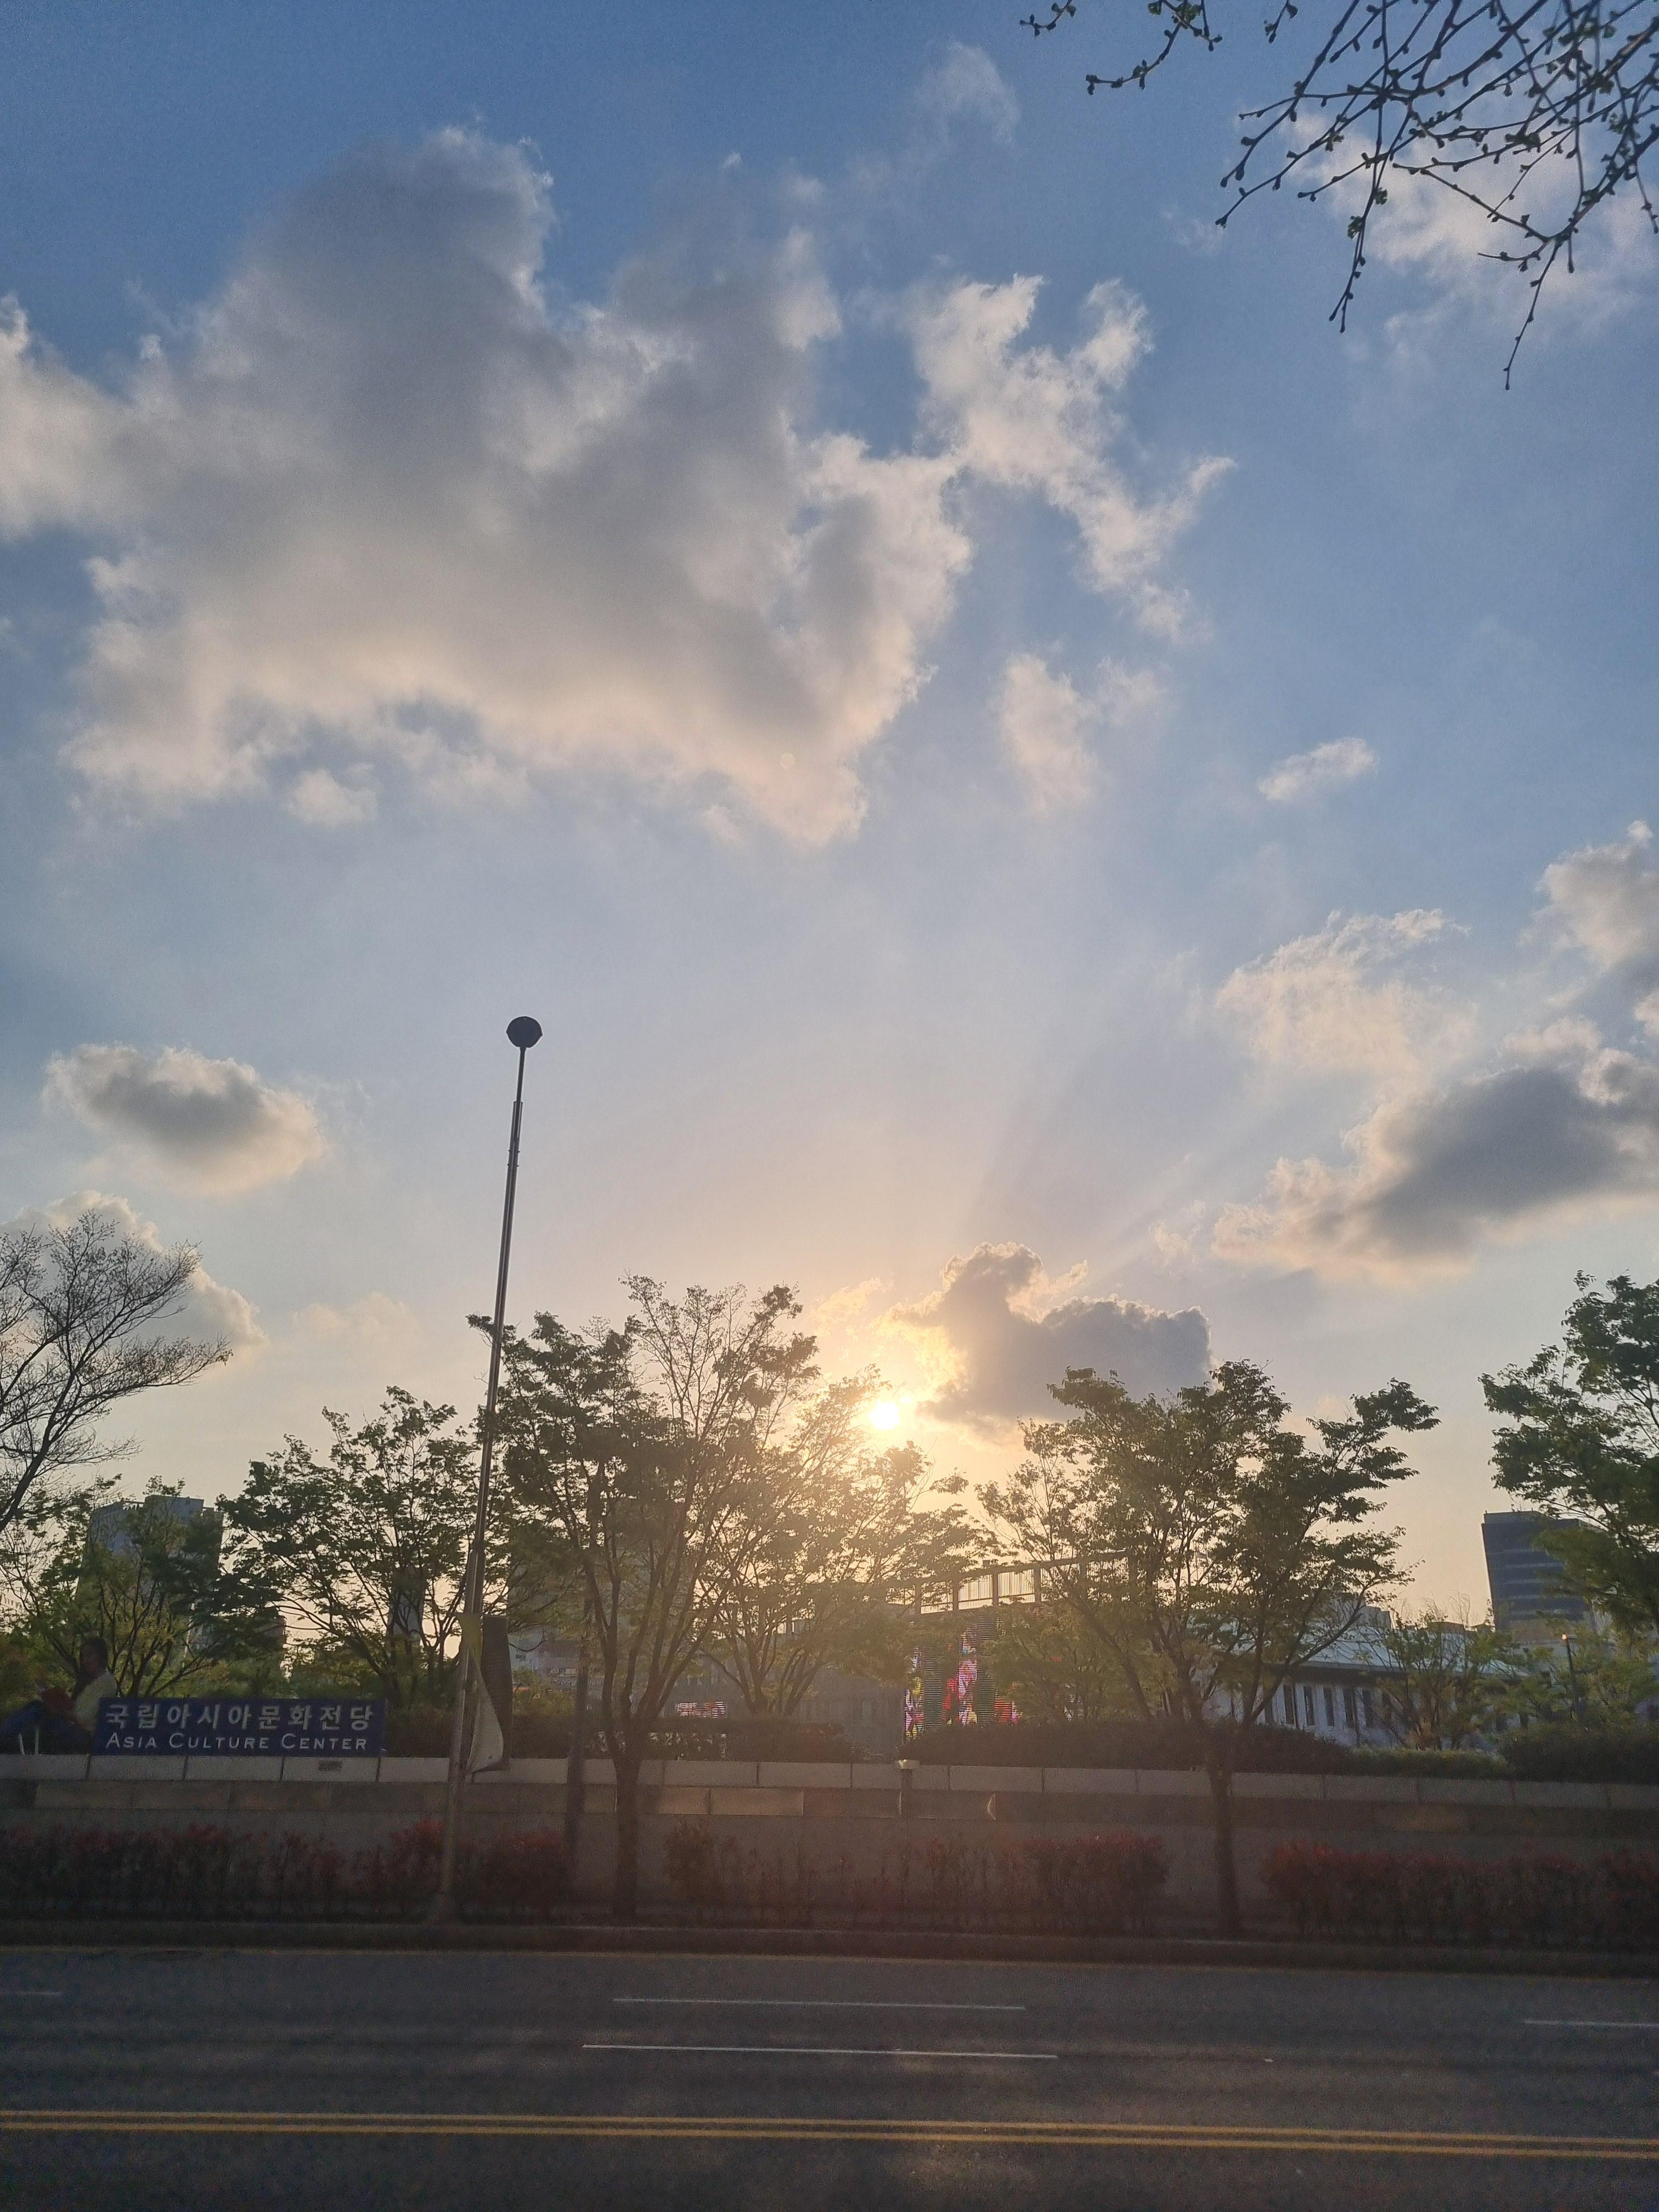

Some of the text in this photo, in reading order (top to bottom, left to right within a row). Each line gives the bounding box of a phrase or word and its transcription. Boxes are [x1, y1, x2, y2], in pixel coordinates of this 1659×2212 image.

[105, 1703, 374, 1730] 국립아시아문화전당
[106, 1732, 368, 1750] ASIA CULTURE CENTER
